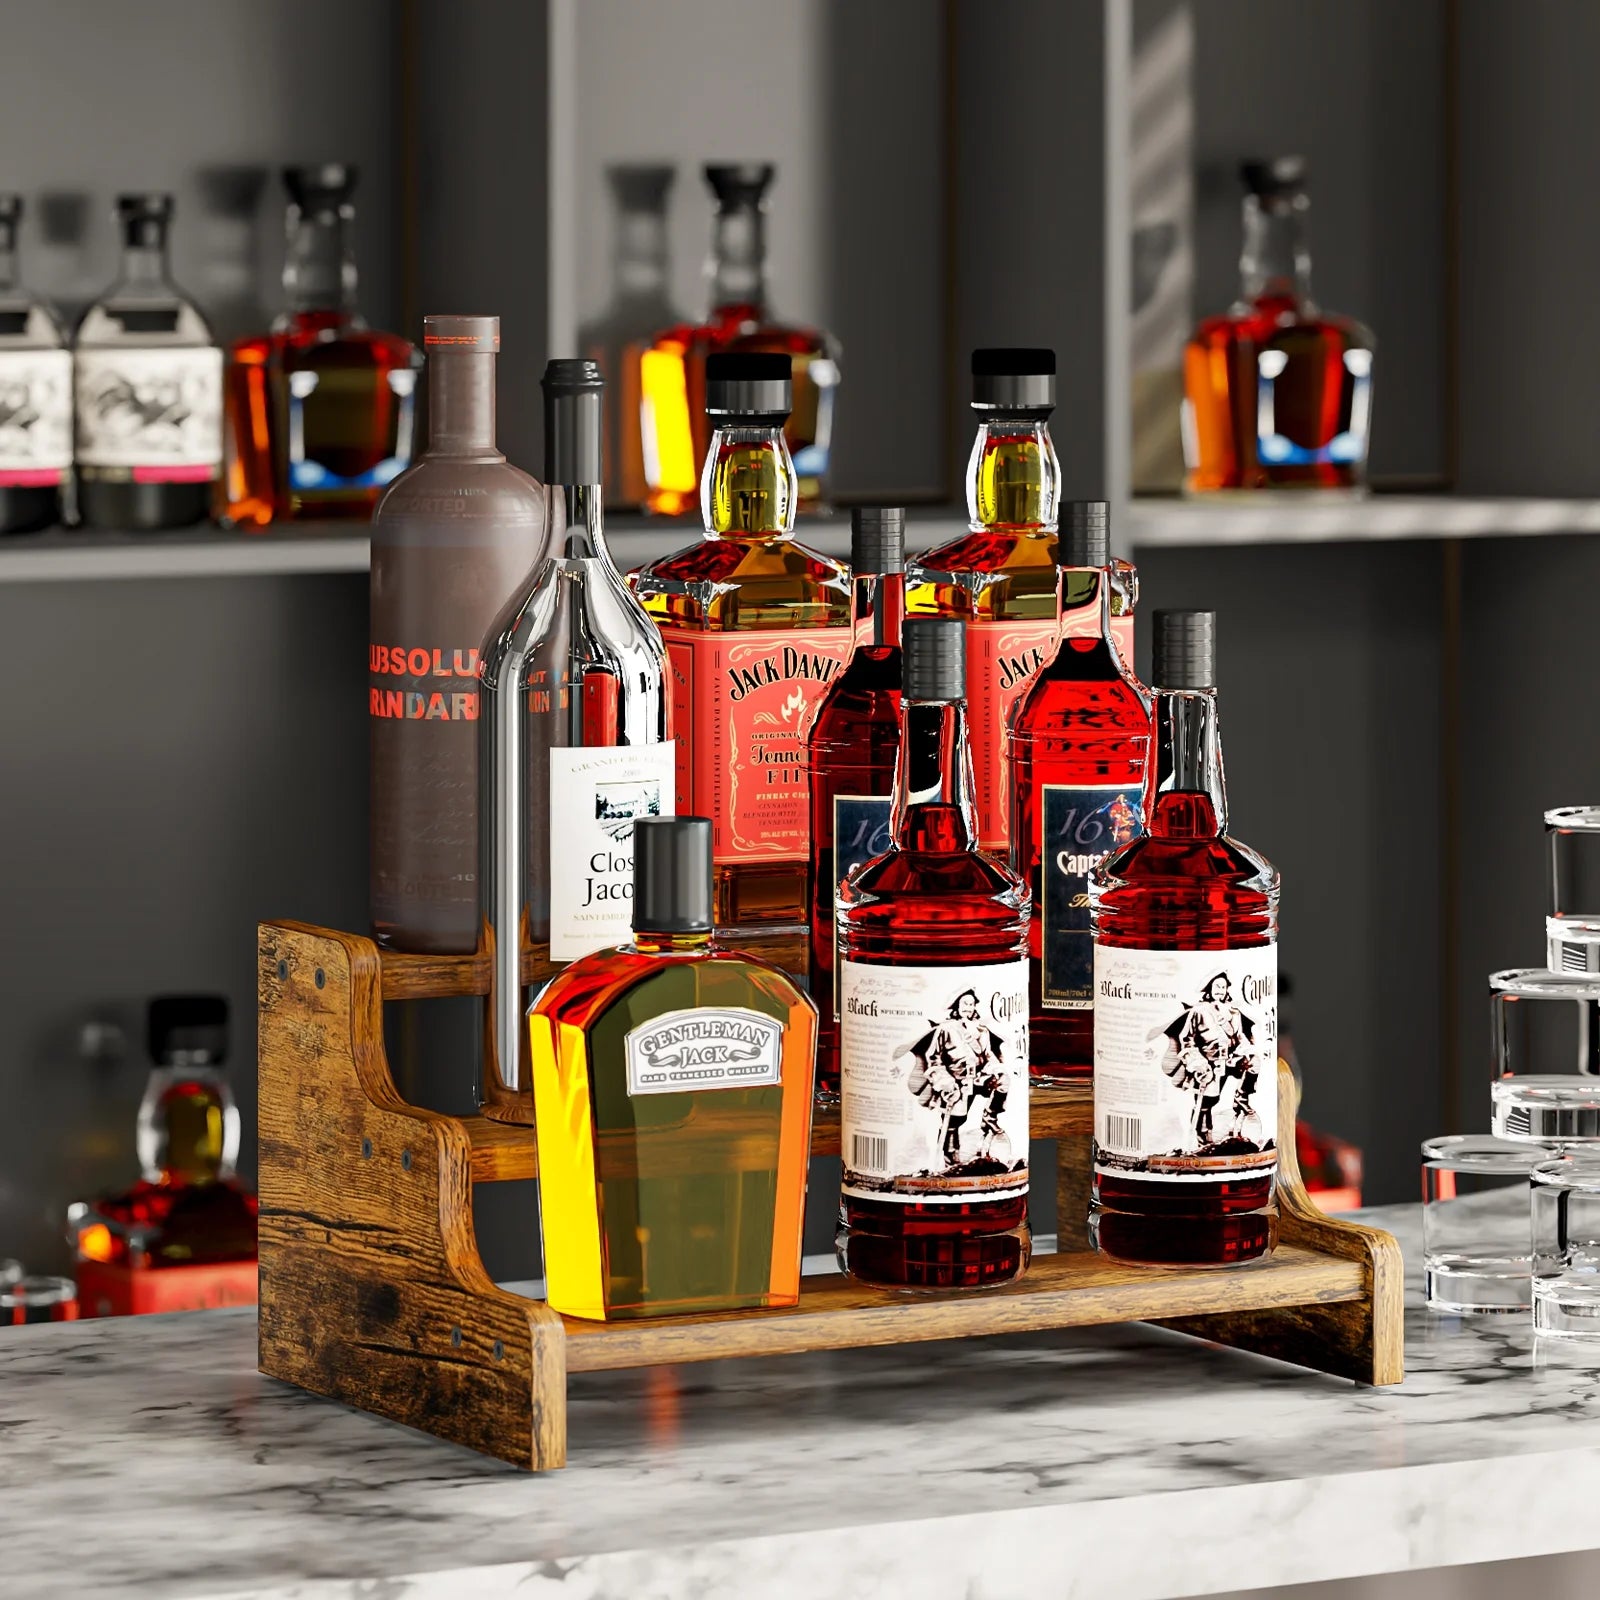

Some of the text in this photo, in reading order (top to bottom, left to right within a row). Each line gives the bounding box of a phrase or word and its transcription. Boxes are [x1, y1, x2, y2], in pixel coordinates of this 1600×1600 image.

[728, 656, 780, 701] JACK
[998, 649, 1044, 689] JACK
[1059, 807, 1104, 845] 16
[1100, 980, 1132, 1000] Black
[847, 997, 878, 1017] Black
[639, 1021, 770, 1057] GENTLEMAN
[680, 1046, 729, 1069] JACK
[669, 1069, 725, 1081] TENNESSEE
[727, 1065, 770, 1076] WHISKEY
